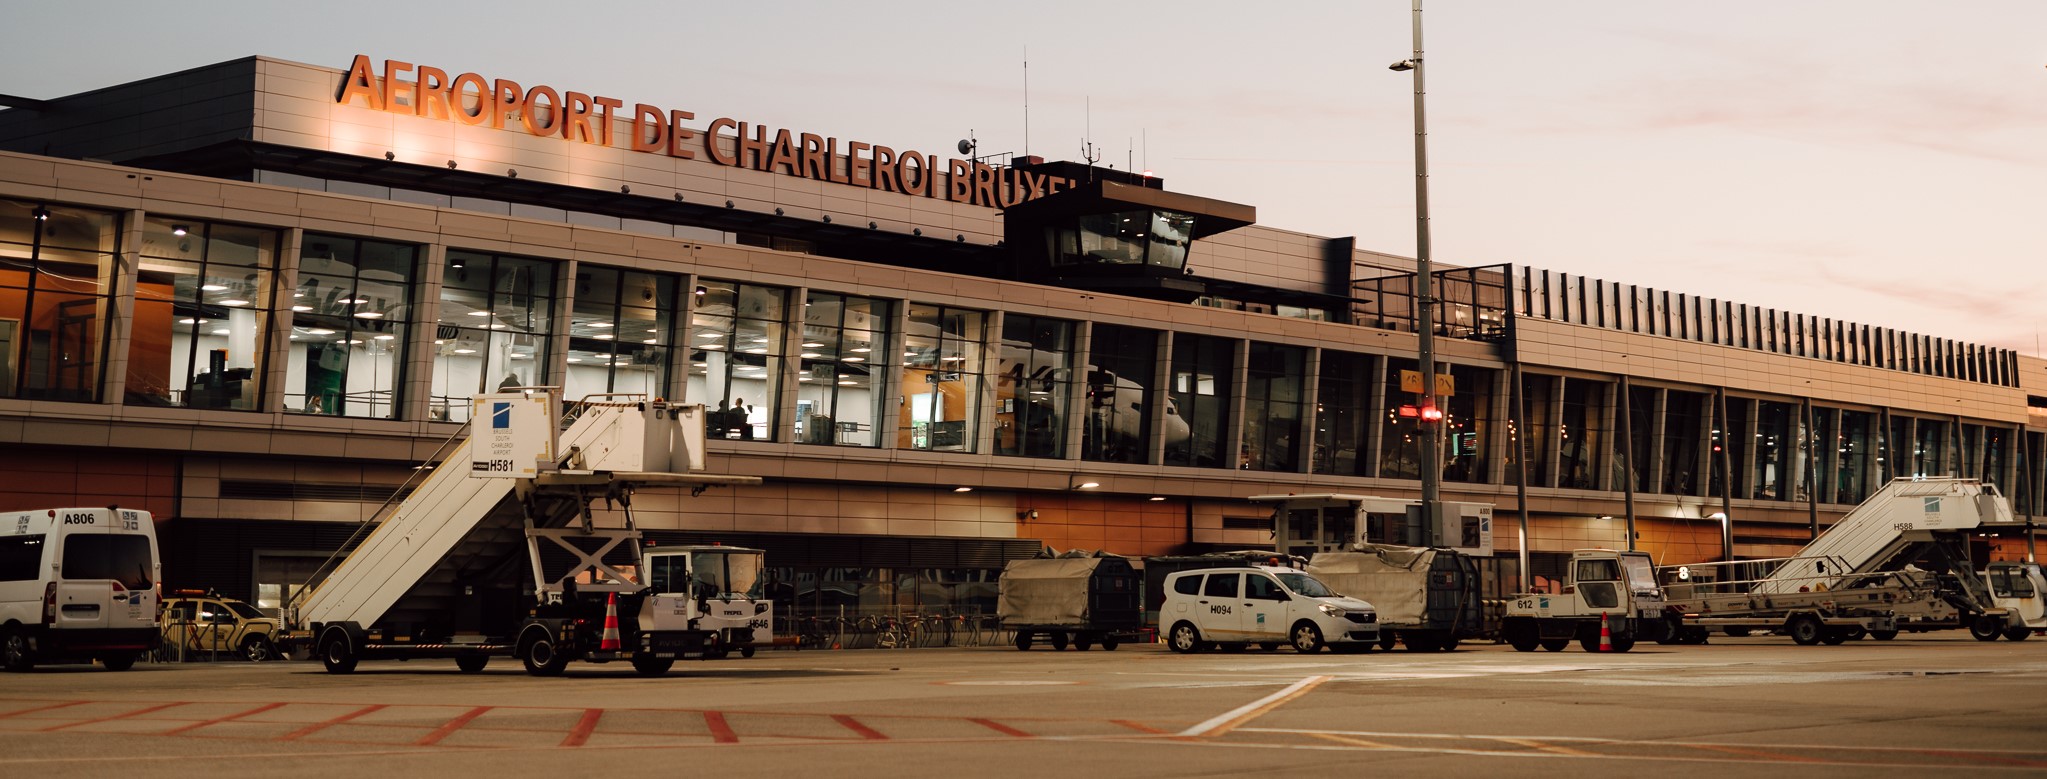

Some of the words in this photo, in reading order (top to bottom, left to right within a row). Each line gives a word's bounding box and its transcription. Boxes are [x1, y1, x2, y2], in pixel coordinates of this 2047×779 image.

[336, 54, 622, 147] AEROPORT
[634, 103, 695, 159] DE
[707, 117, 938, 198] CHARLEROI
[490, 459, 514, 472] H581
[64, 513, 95, 525] A806
[1893, 522, 1914, 531] H588
[1678, 566, 1689, 580] 8
[1210, 604, 1232, 615] H094
[1517, 600, 1533, 609] 612
[749, 619, 769, 629] H646
